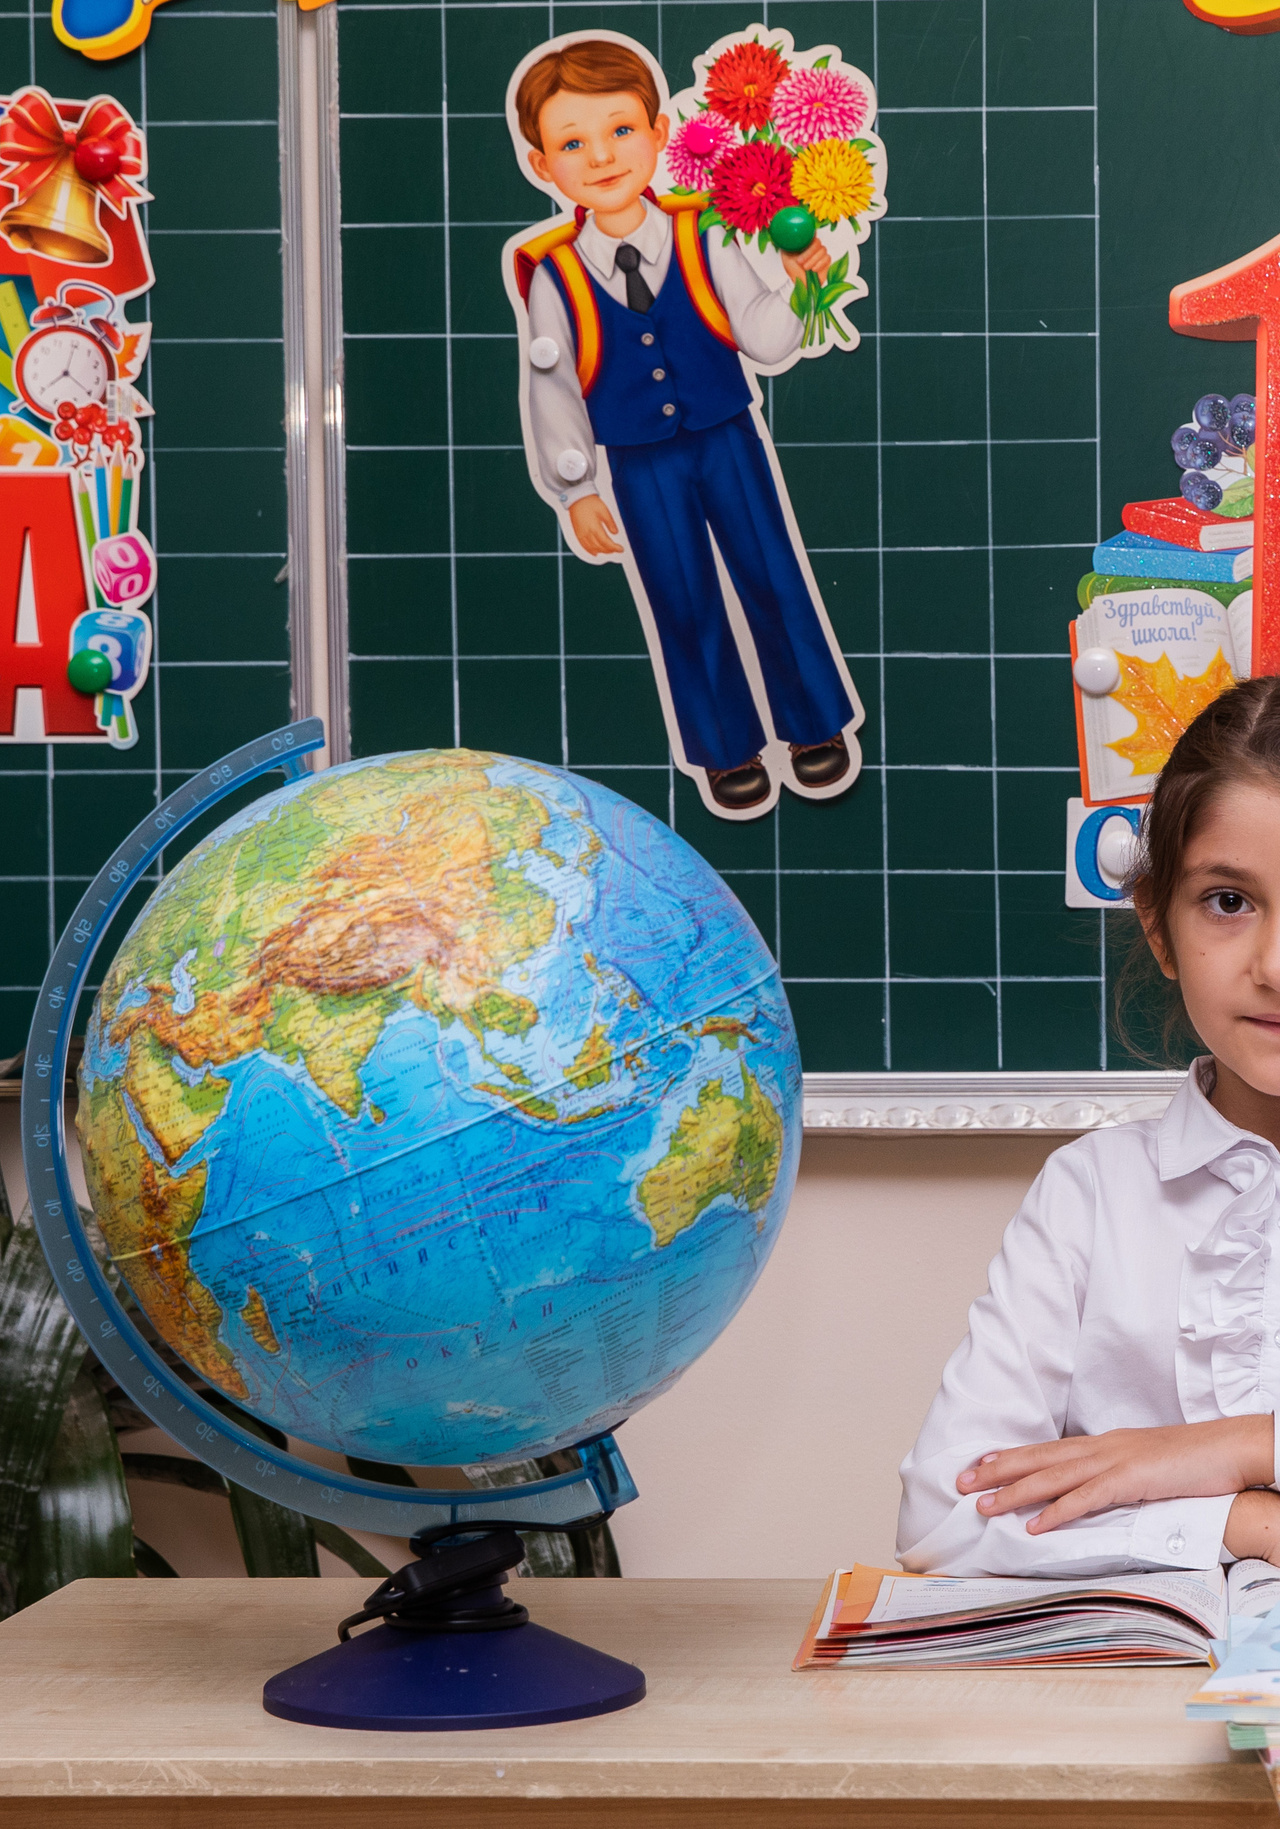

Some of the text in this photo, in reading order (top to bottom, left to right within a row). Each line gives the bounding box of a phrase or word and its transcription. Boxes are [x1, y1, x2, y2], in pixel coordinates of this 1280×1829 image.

[1102, 594, 1222, 628] Здравствуй,
[1132, 621, 1198, 647] школа!
[405, 1301, 554, 1371] ОКЕАН
